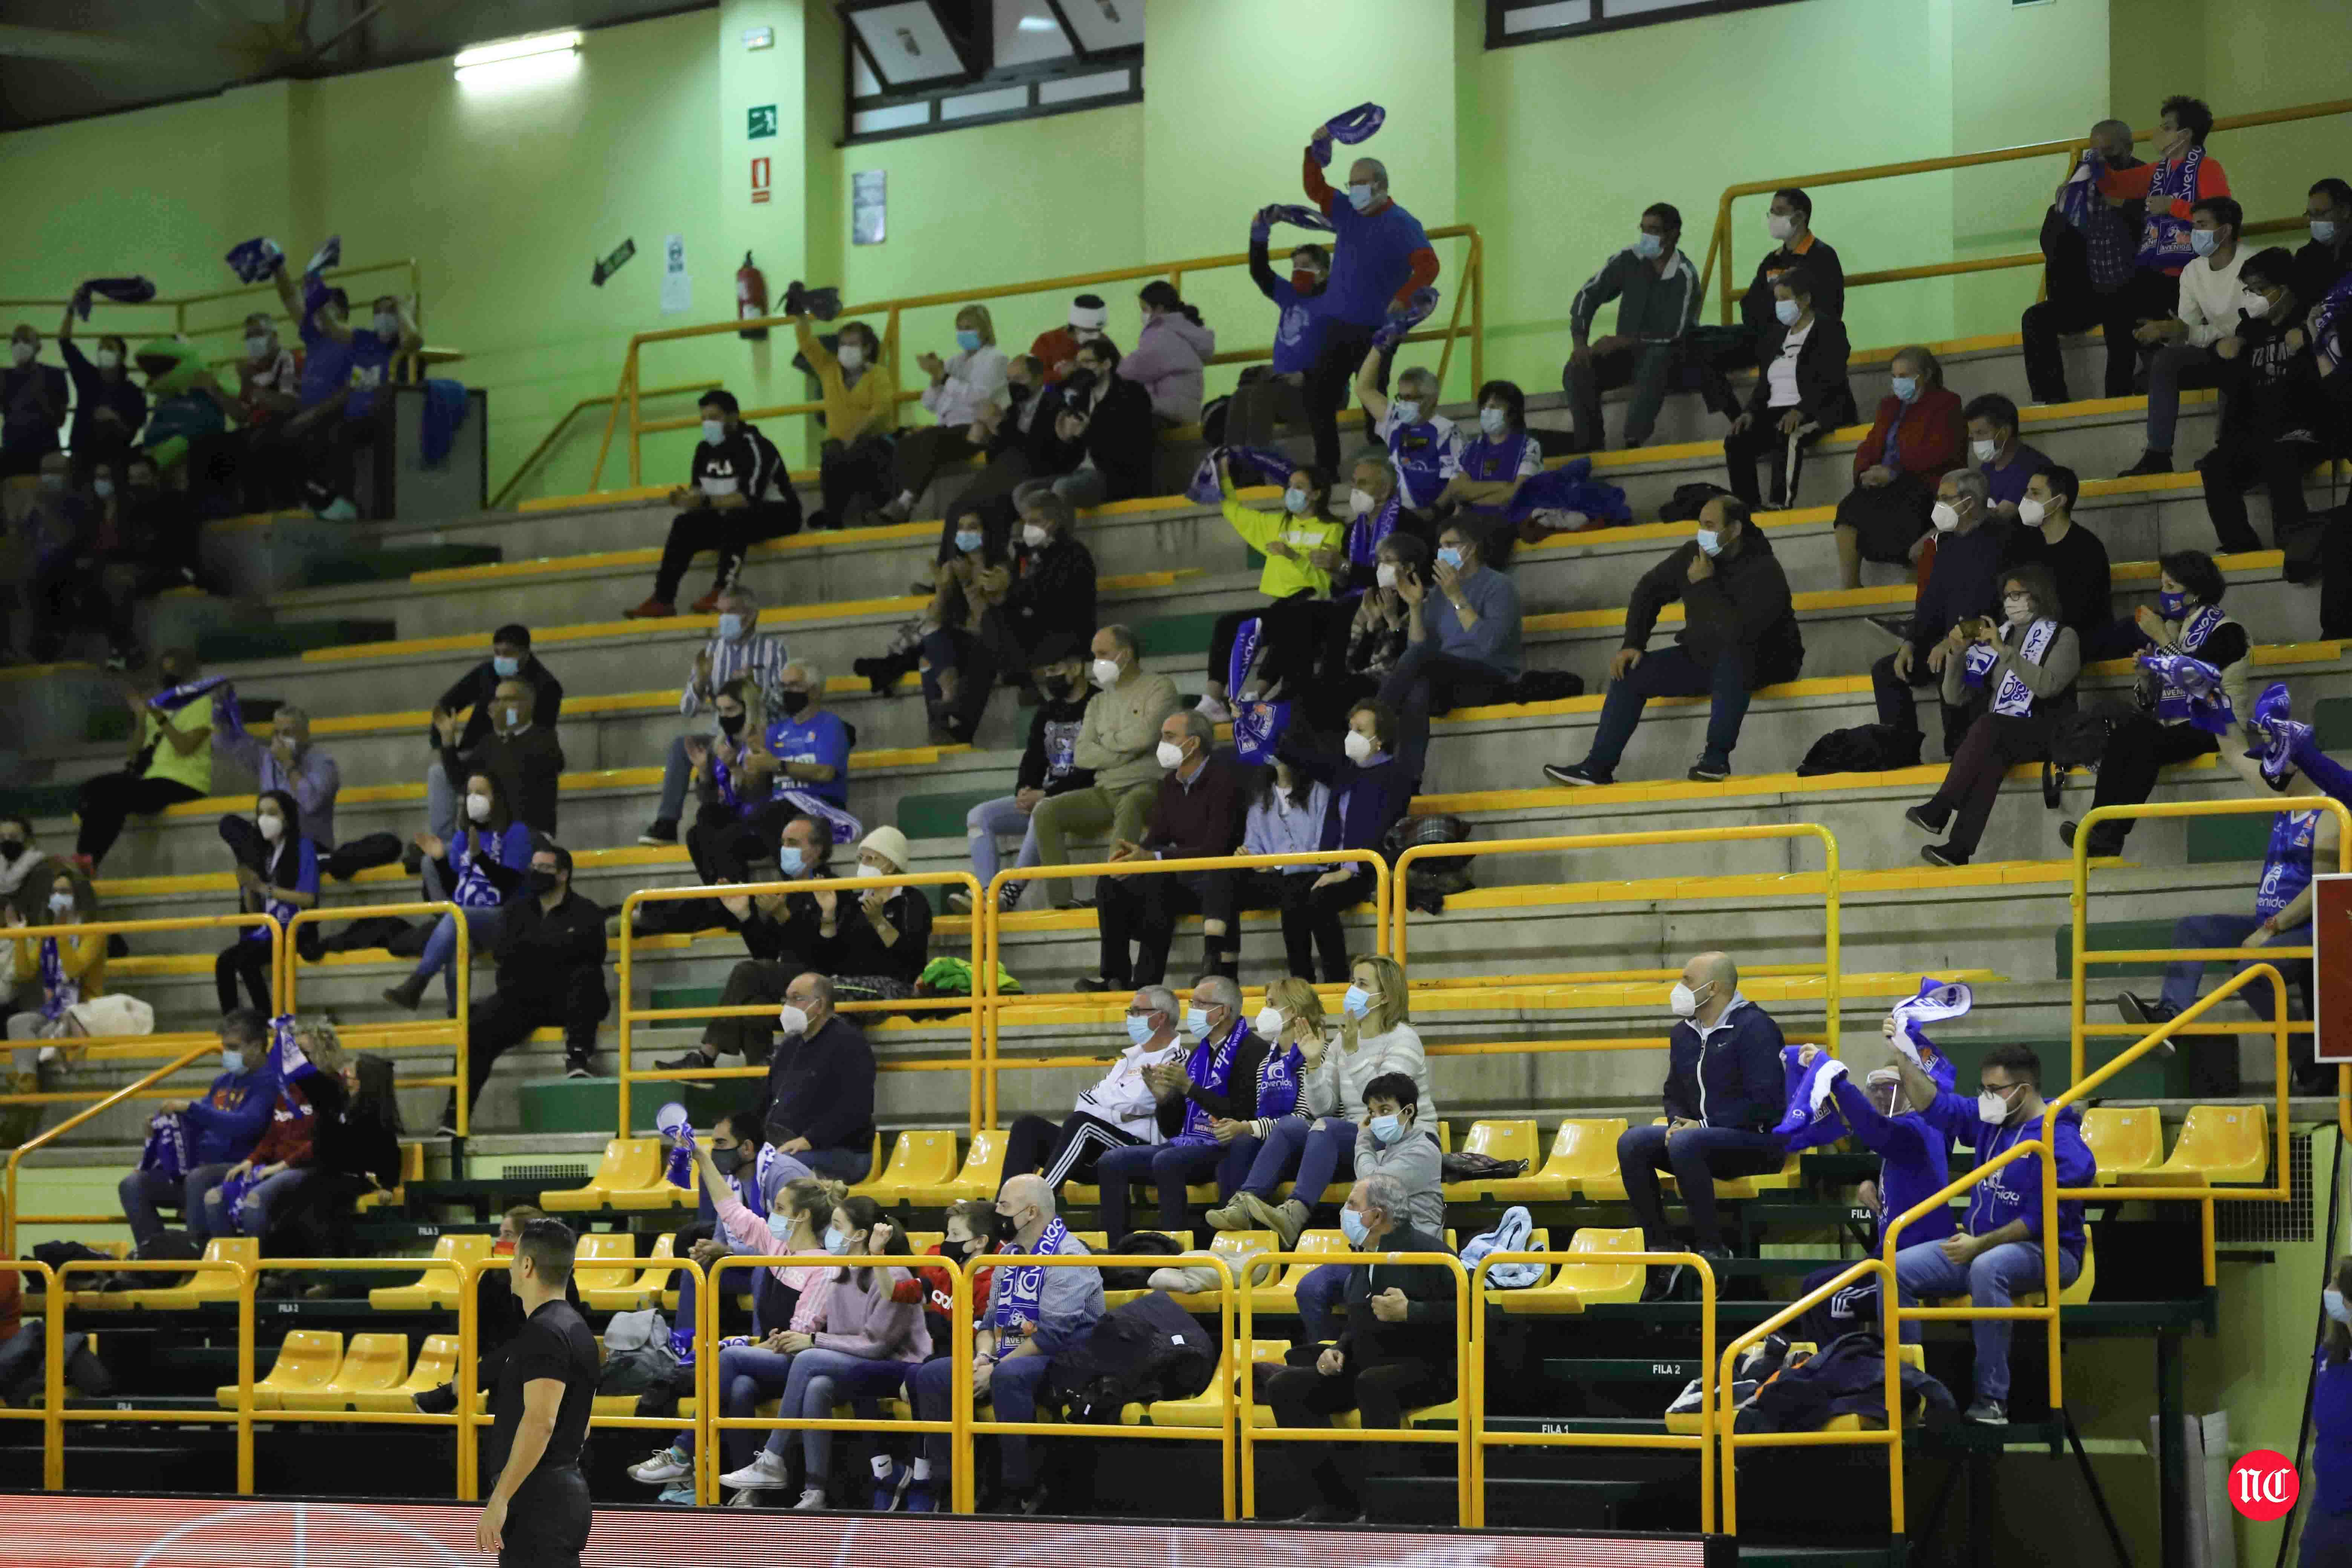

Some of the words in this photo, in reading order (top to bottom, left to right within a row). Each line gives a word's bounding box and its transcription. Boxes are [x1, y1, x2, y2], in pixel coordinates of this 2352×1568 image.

[1851, 1209, 1871, 1219] FILA
[1652, 1364, 1672, 1375] FILA
[1674, 1364, 1680, 1375] 2
[1542, 1424, 1562, 1433] FILA
[1563, 1424, 1568, 1433] 1
